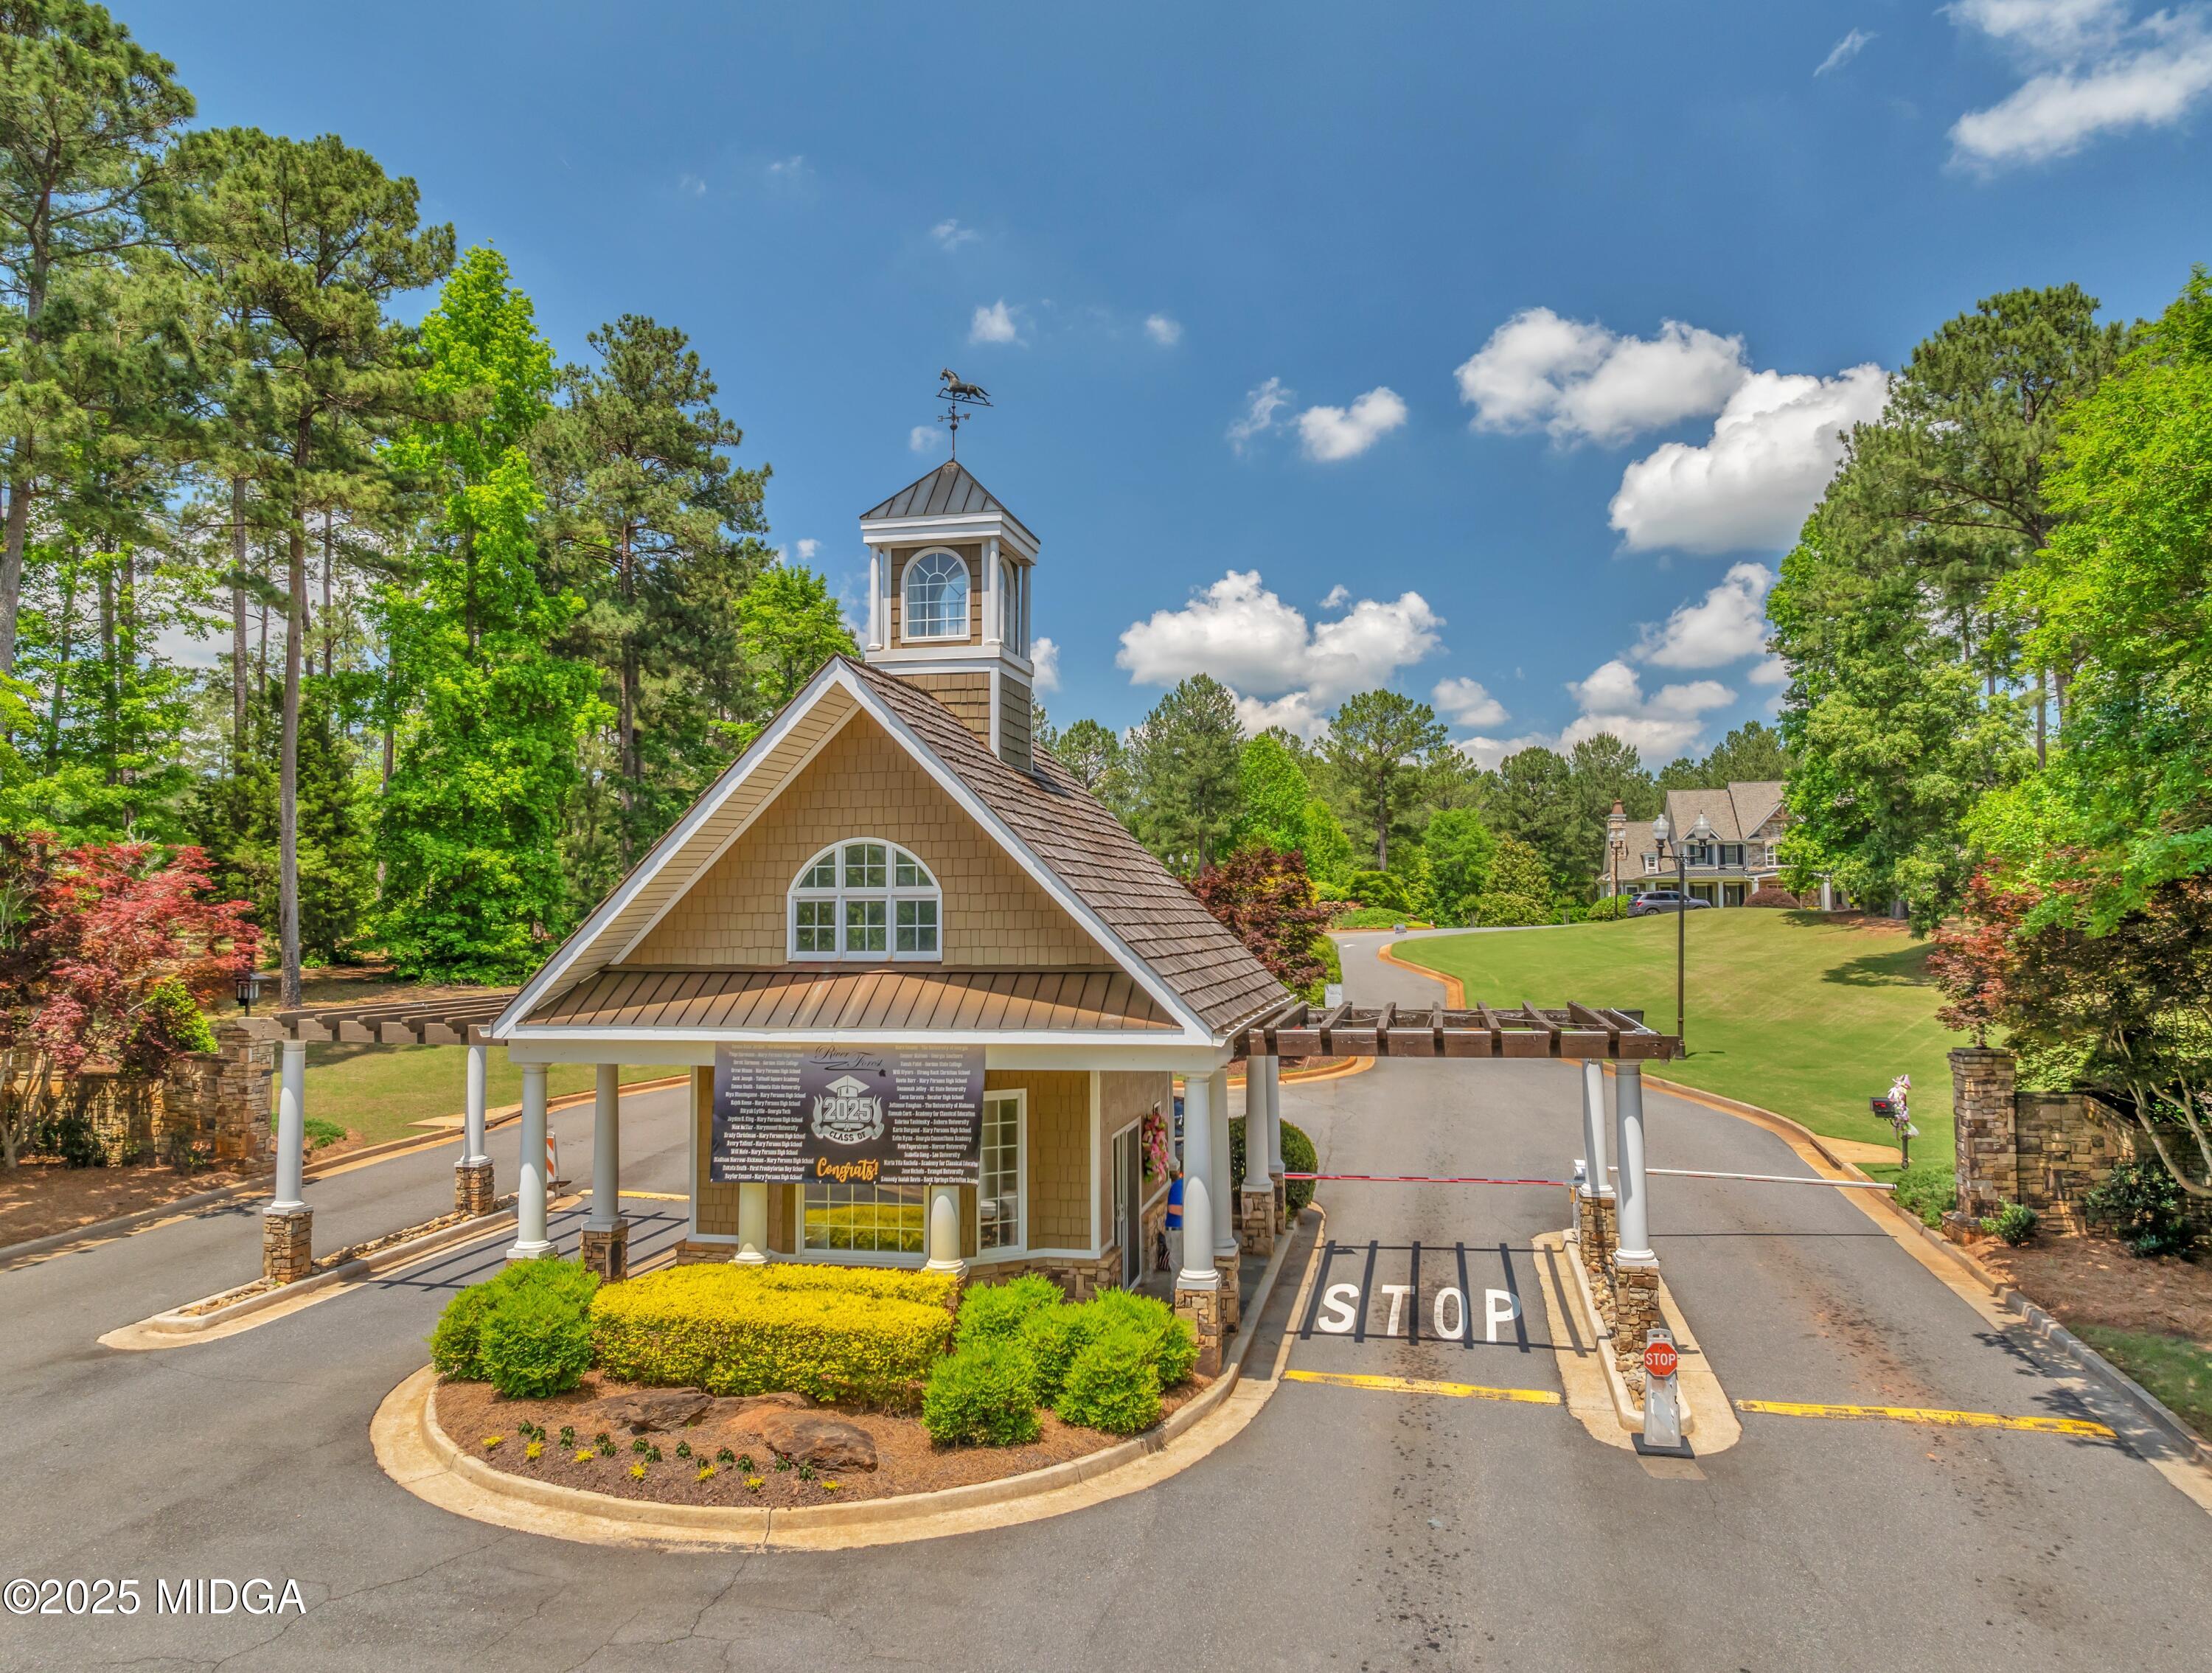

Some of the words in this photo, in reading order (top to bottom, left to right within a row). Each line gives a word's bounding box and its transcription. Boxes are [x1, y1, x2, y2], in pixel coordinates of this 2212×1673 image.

[815, 1045, 849, 1060] River
[847, 1051, 883, 1068] Forest
[823, 1096, 873, 1123] 2025
[829, 1130, 854, 1141] CLASS
[858, 1130, 866, 1140] OF
[817, 1156, 879, 1183] Congrats!
[1318, 1283, 1521, 1343] STOP
[1646, 1353, 1676, 1366] STOP
